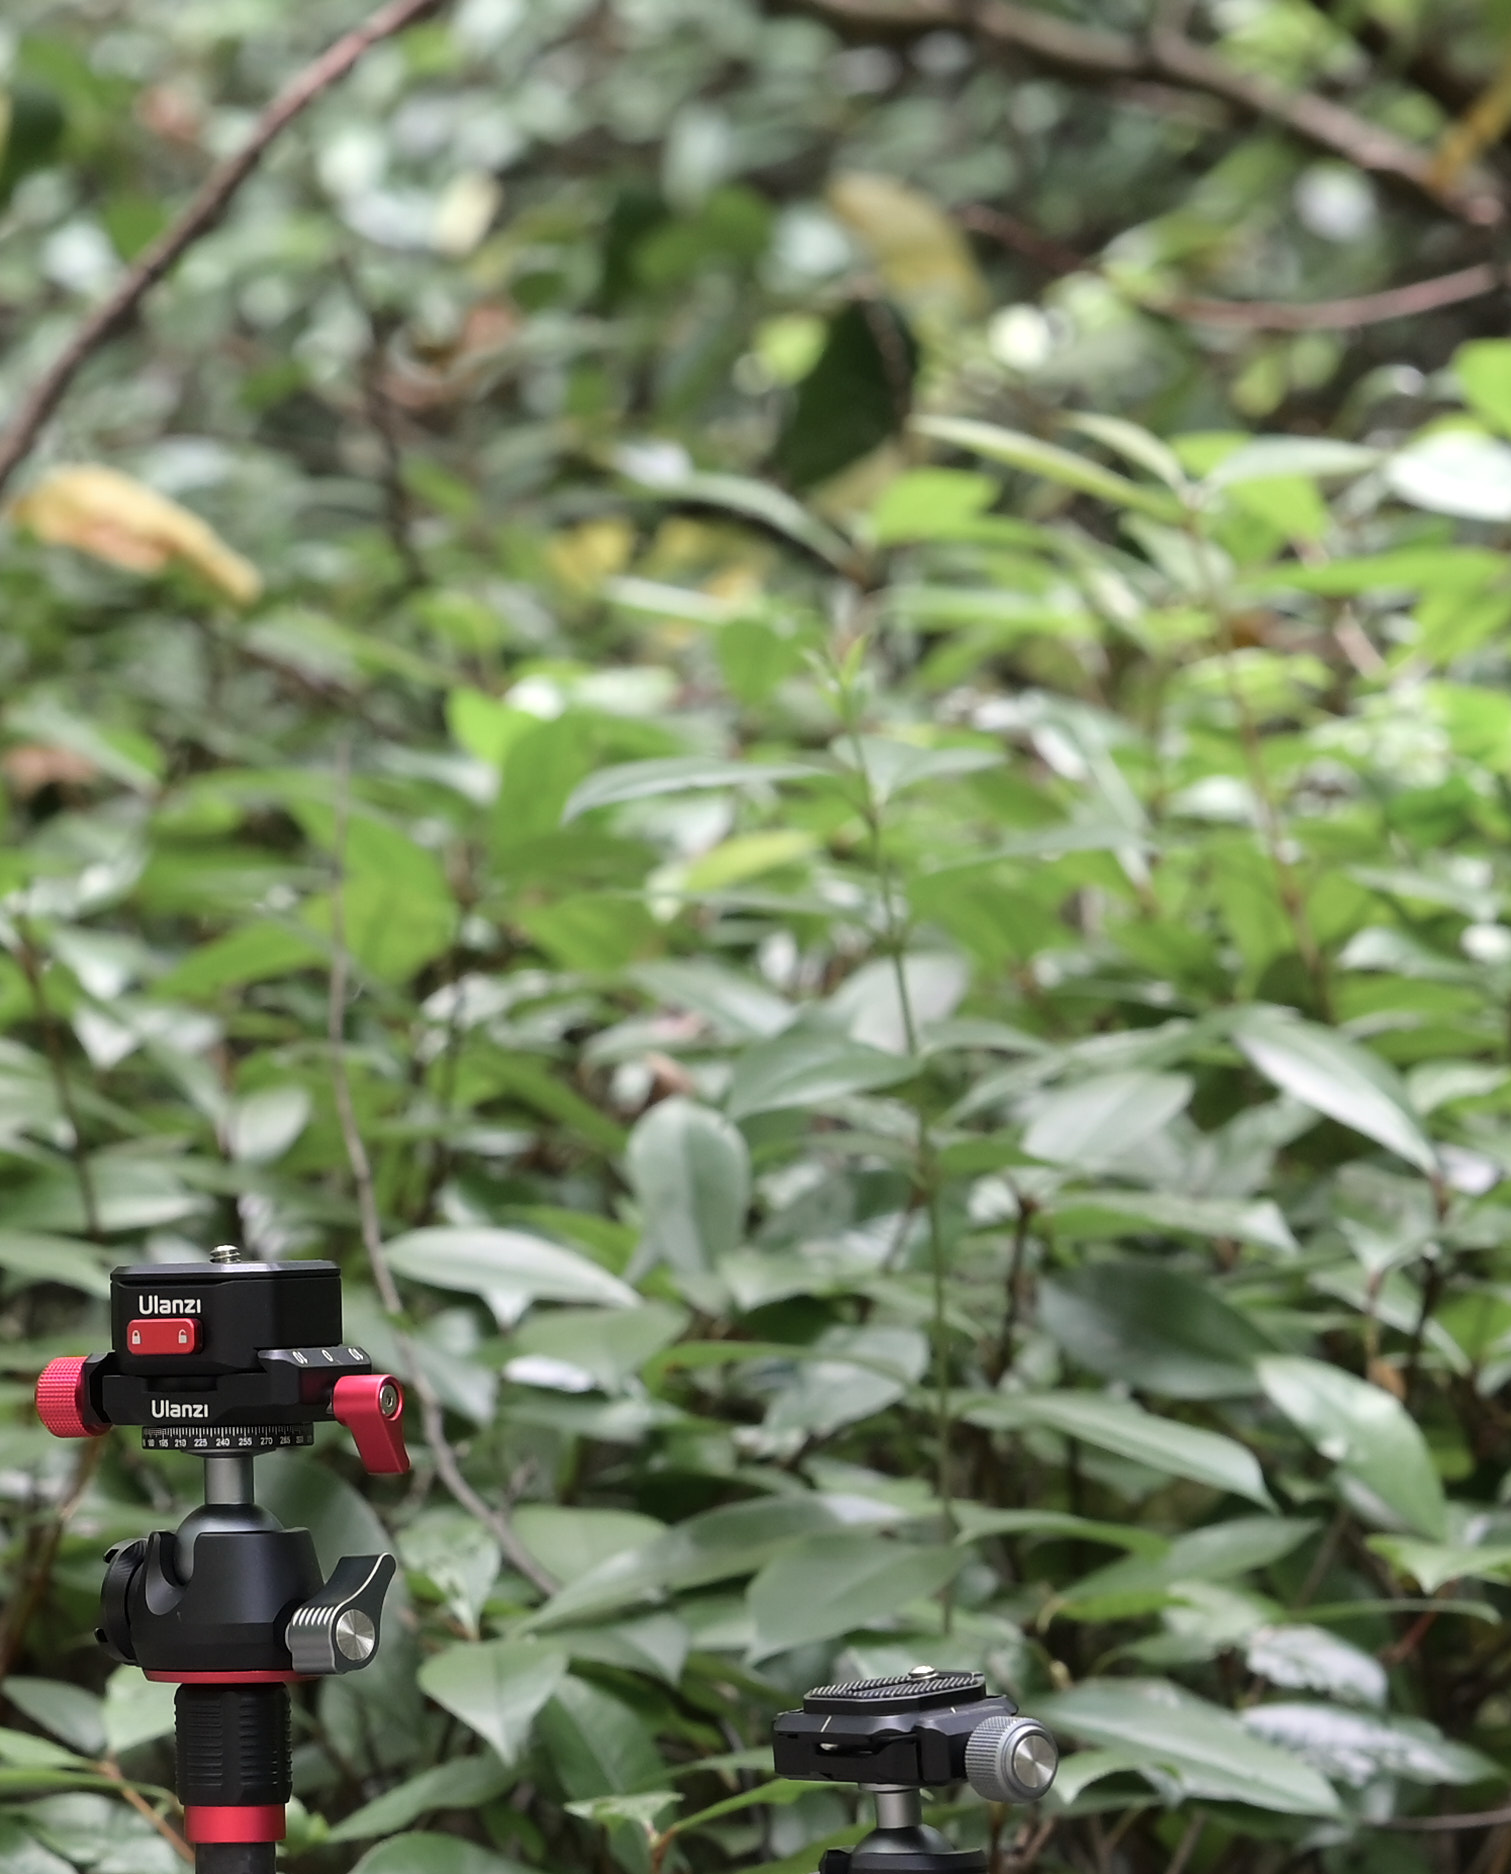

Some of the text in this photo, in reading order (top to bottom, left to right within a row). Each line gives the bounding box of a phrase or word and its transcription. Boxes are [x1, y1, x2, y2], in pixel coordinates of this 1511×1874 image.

[138, 1294, 202, 1315] Ulanzi
[150, 1399, 209, 1418] Ulanzi
[215, 1437, 231, 1447] 240
[238, 1436, 253, 1446] 255
